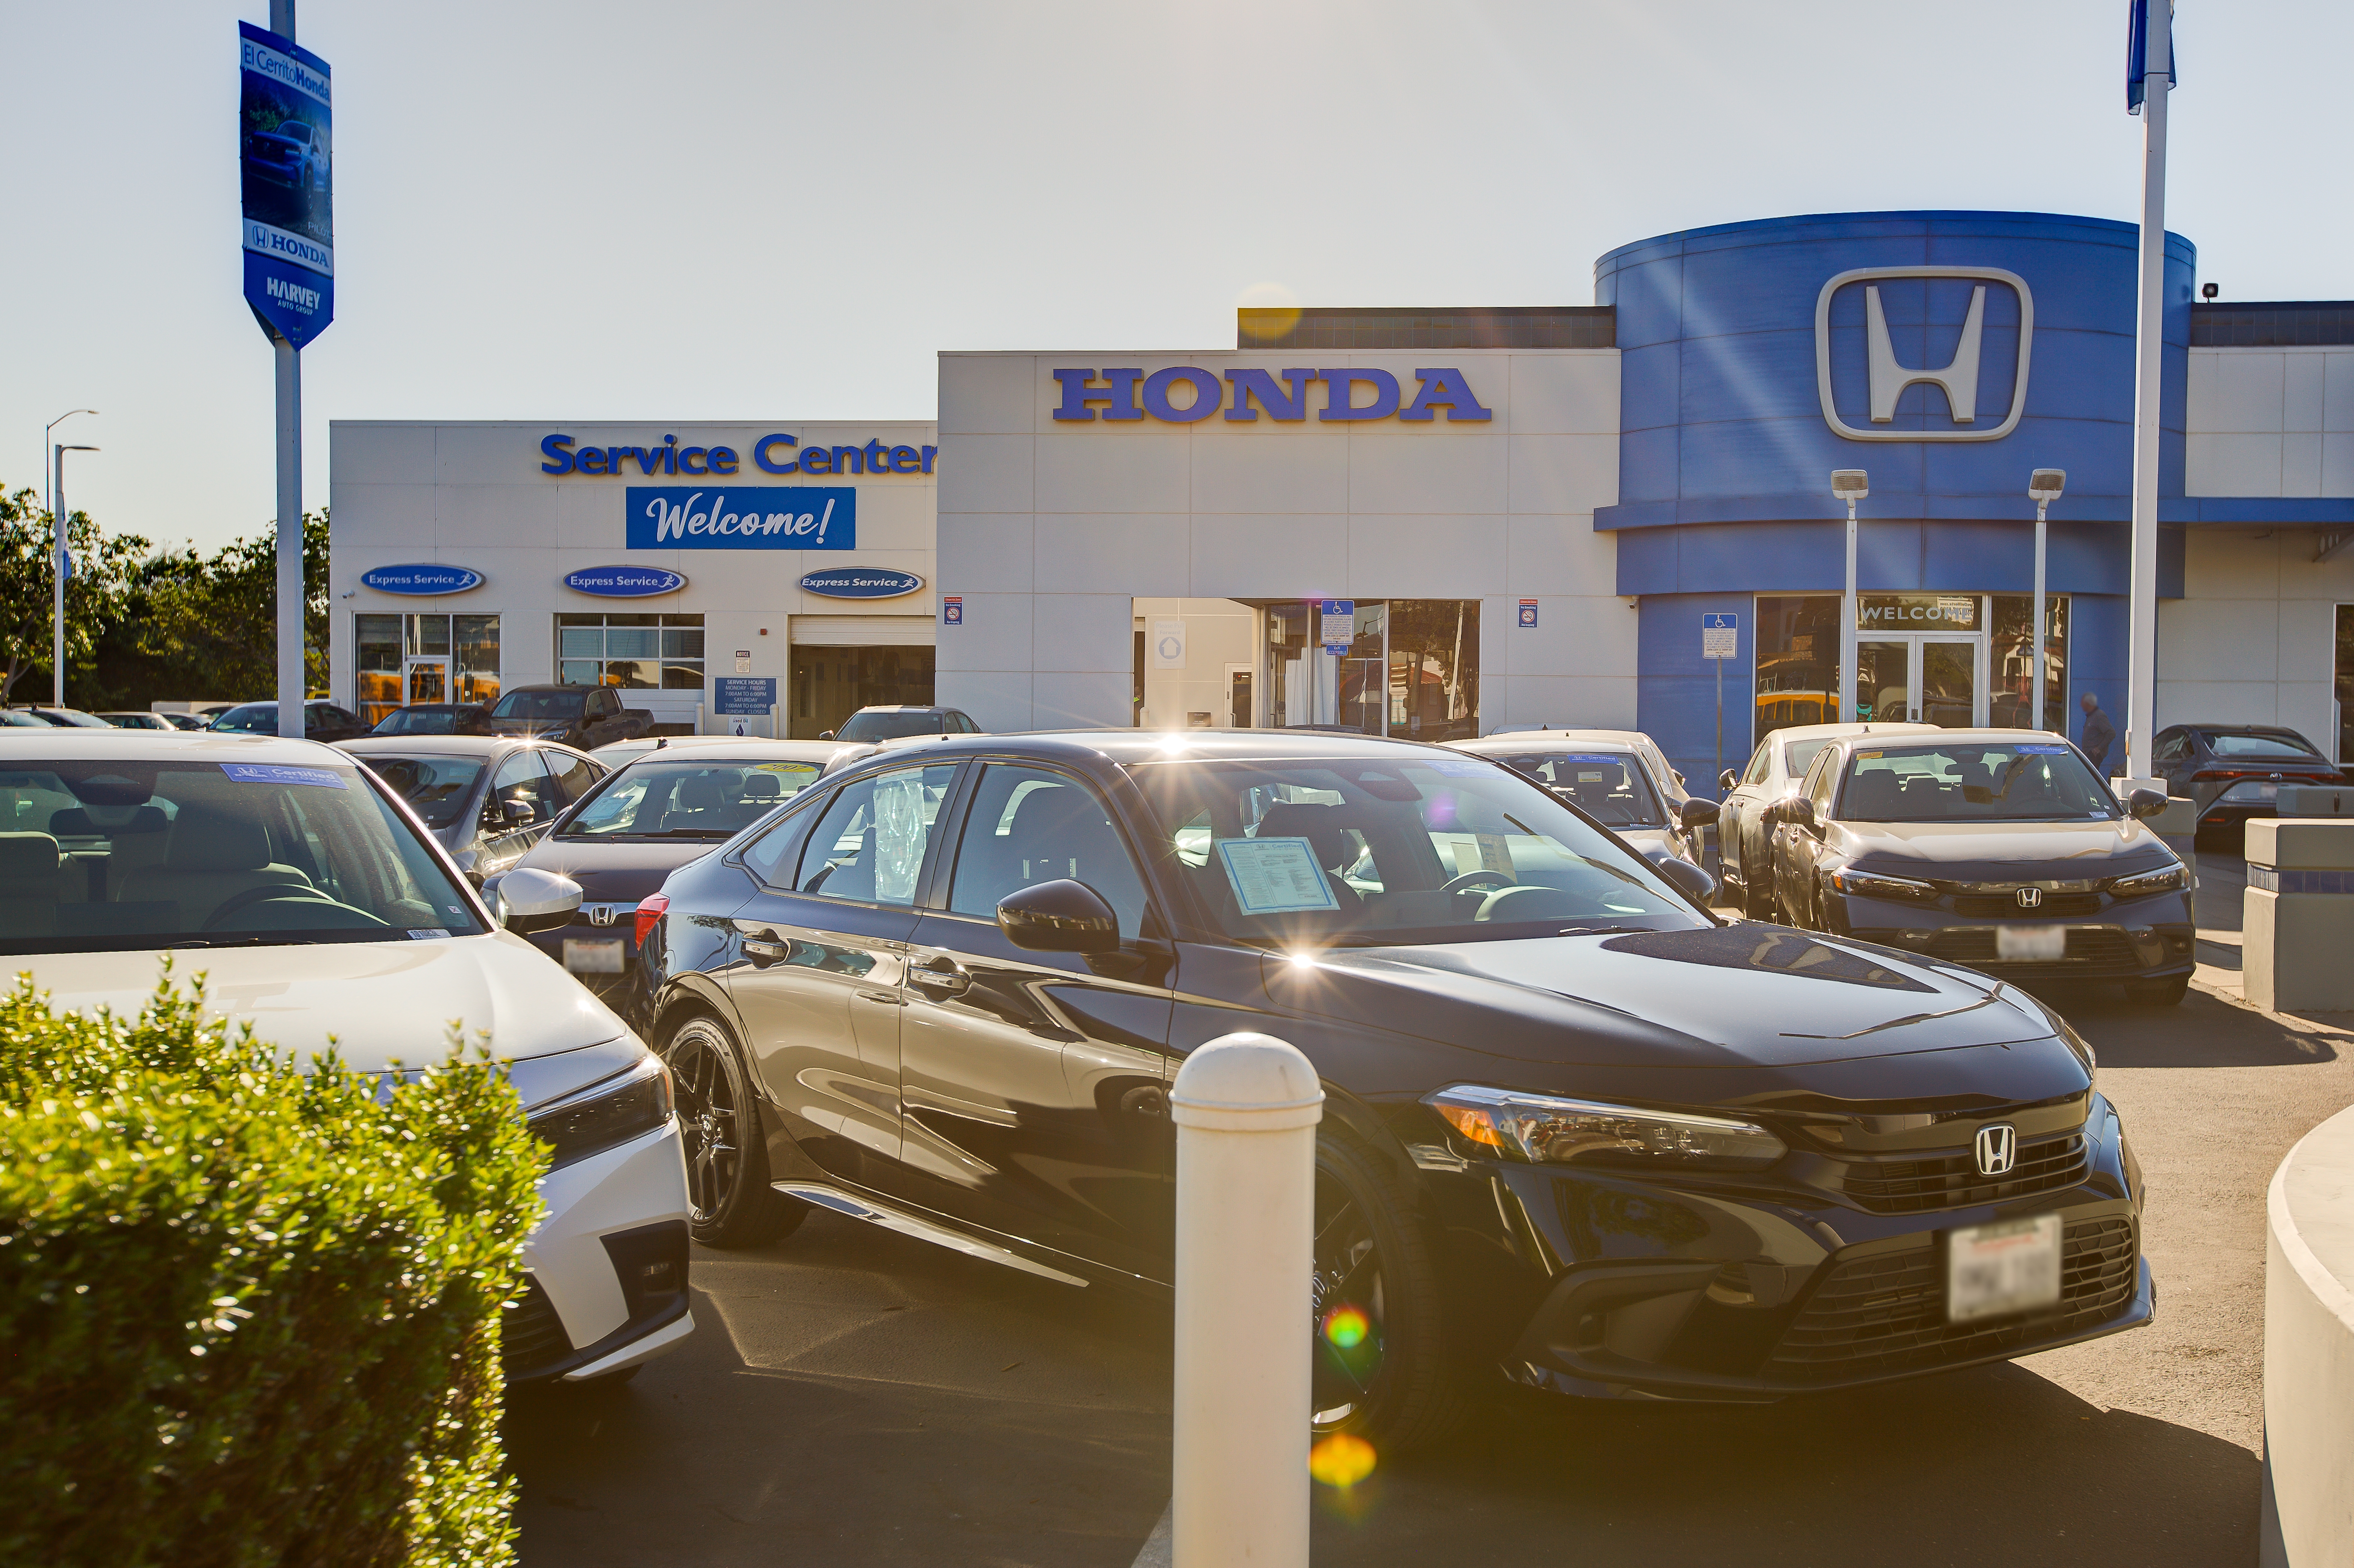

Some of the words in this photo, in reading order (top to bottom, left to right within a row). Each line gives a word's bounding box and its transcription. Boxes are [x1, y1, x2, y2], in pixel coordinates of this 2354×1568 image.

[308, 221, 331, 238] PILOT
[271, 233, 329, 268] HONDA
[267, 277, 321, 310] HARVEY
[278, 300, 294, 311] AUTO
[1052, 366, 1493, 423] HONDA
[540, 433, 739, 475] Service
[754, 433, 937, 475] Center
[646, 492, 835, 544] Welcome!
[369, 574, 411, 585] Express
[414, 574, 455, 584] Service
[570, 575, 613, 588] Express
[617, 575, 658, 586] Service
[802, 578, 850, 588] Express
[852, 577, 898, 587] Service
[1861, 607, 1973, 620] WELCOME
[271, 769, 336, 780] Certified
[683, 1026, 723, 1046] GOODYEAR
